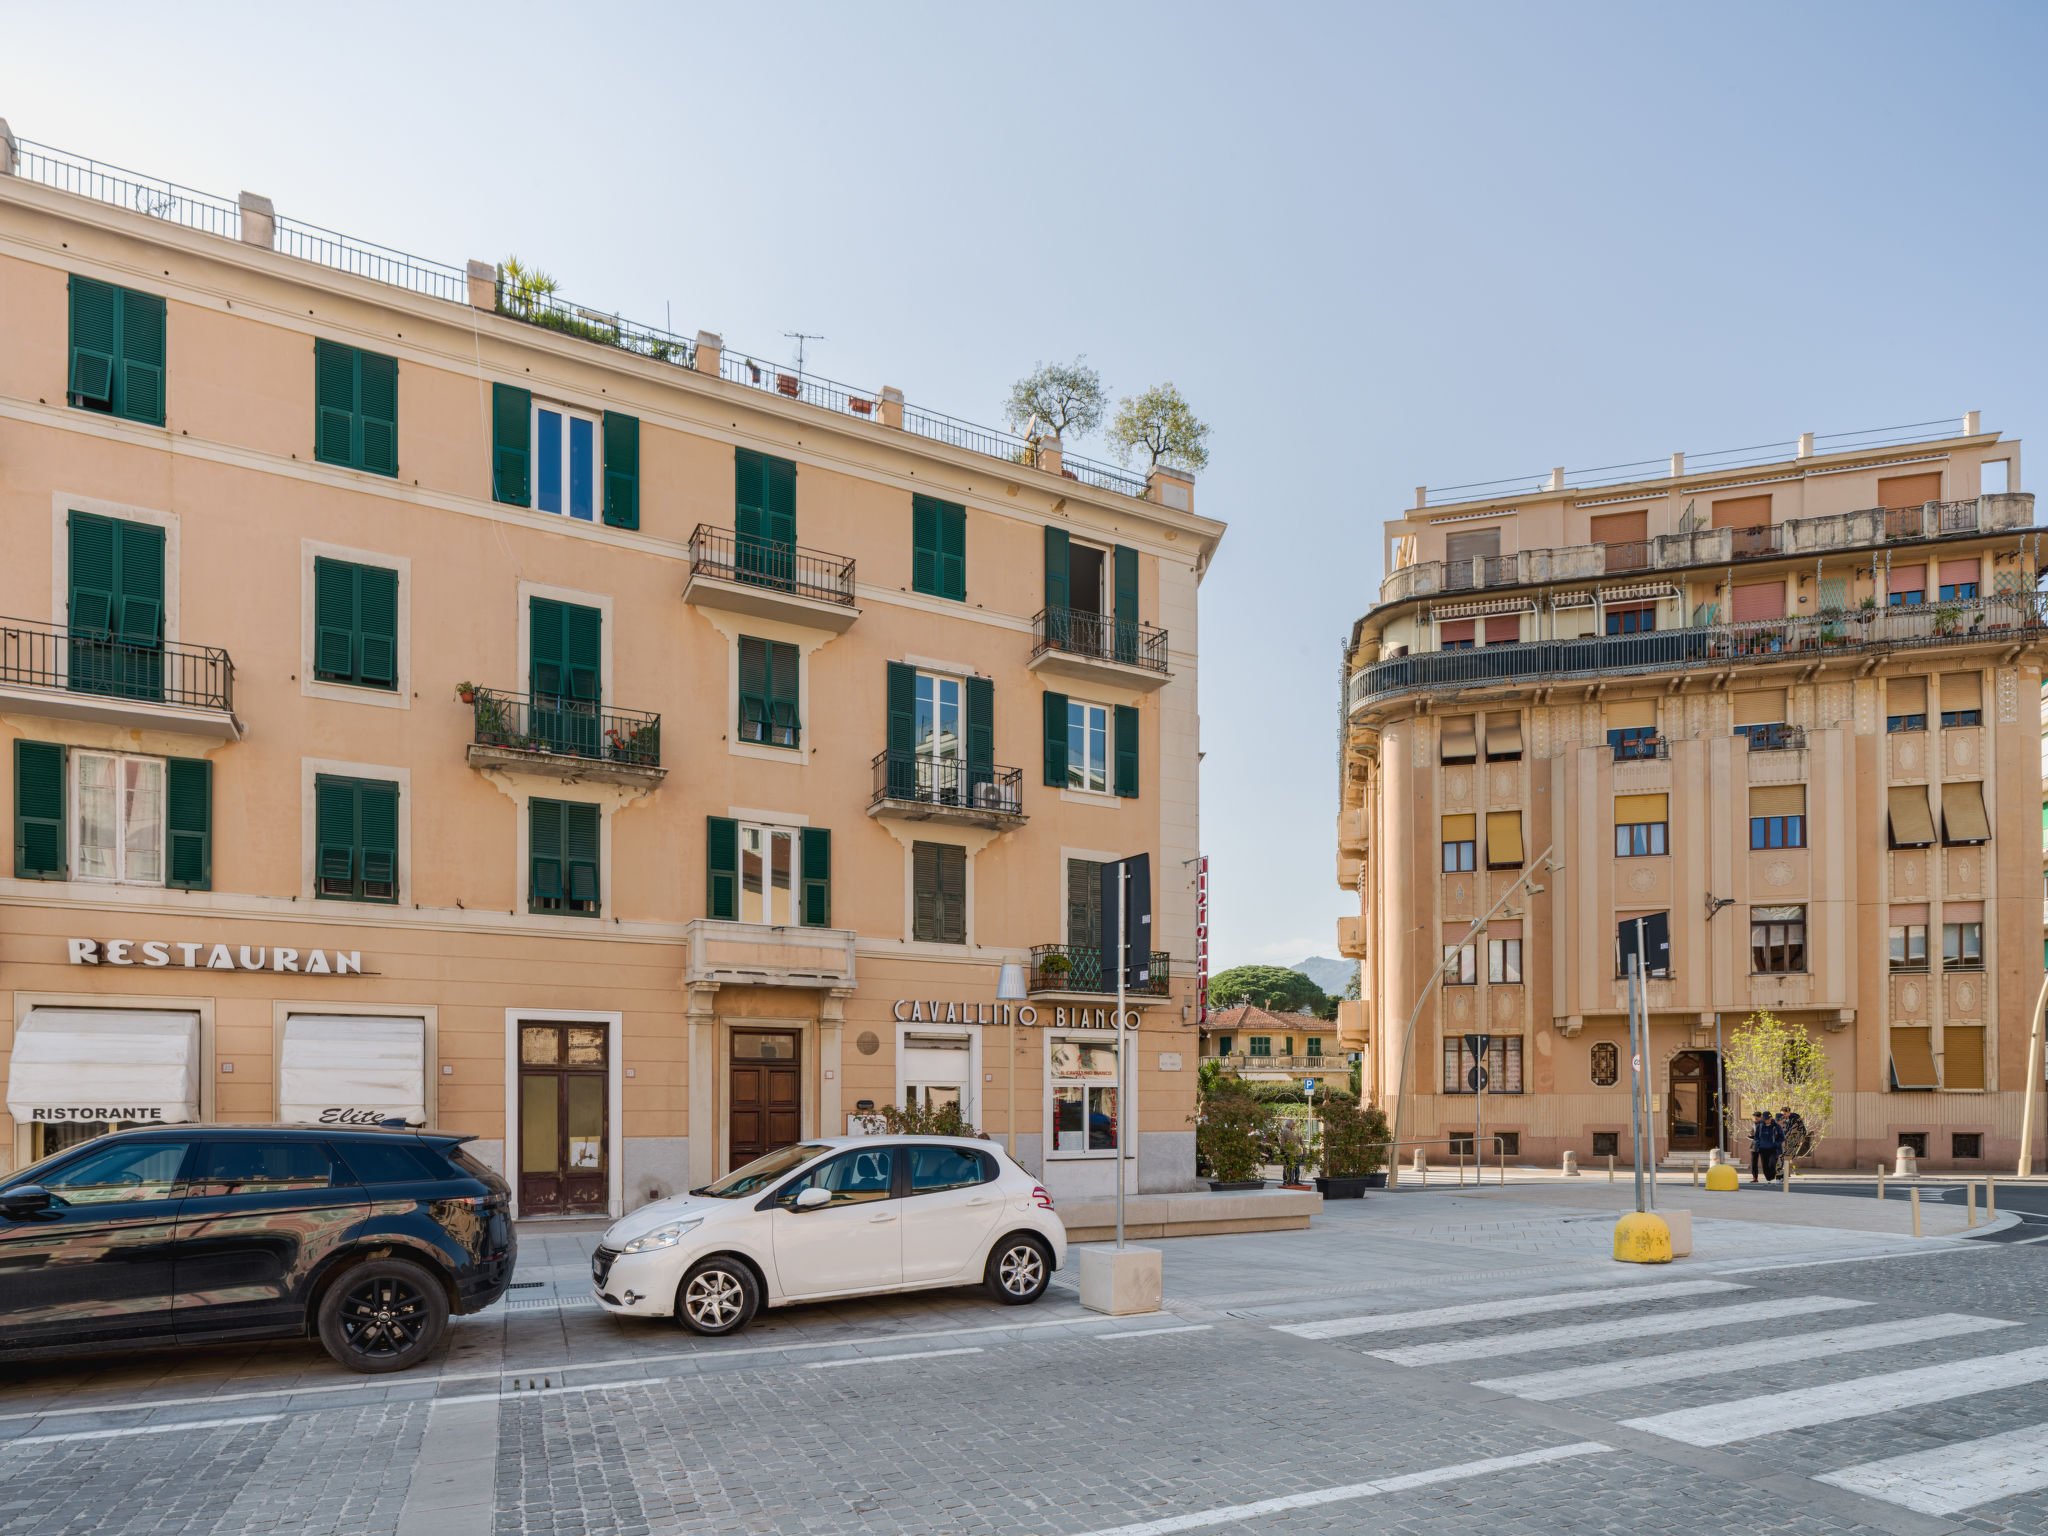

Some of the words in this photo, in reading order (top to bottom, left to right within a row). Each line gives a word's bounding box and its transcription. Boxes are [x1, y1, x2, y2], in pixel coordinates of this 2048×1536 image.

[67, 938, 361, 974] RESTAURAN
[894, 1000, 1038, 1026] CAVALLINO
[1056, 1006, 1141, 1030] BIANCO
[1306, 1080, 1312, 1088] P
[32, 1107, 162, 1119] RISTORANTE
[319, 1108, 386, 1124] Elite
